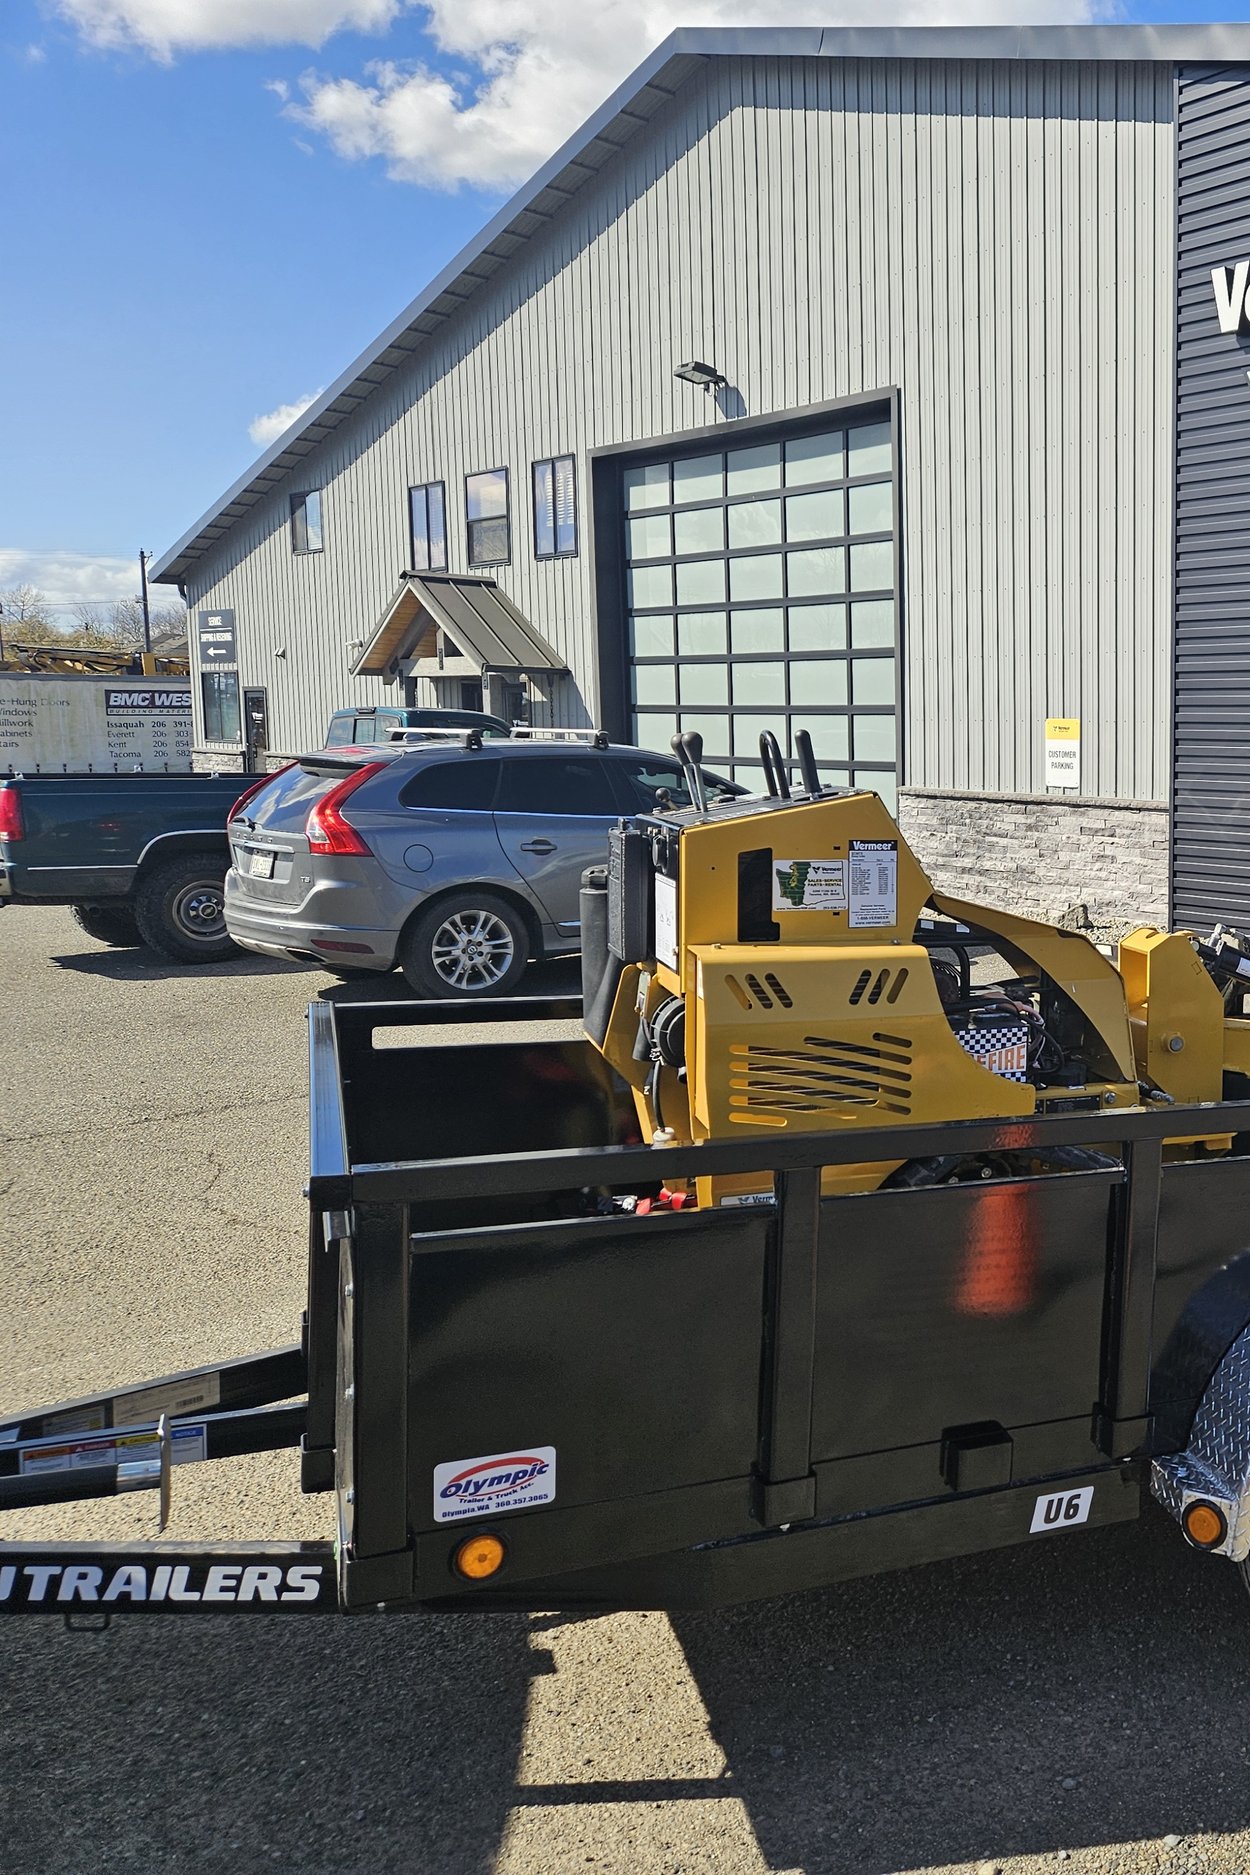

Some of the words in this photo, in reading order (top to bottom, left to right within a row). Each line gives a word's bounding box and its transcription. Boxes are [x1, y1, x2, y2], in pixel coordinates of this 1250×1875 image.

[0, 698, 37, 707] e-Hung
[109, 692, 151, 706] BMC
[154, 693, 192, 706] WES
[107, 721, 145, 729] Issaquah
[1048, 750, 1077, 759] CUSTOMER
[1051, 761, 1074, 770] PARKING
[853, 841, 892, 850] Vermeer
[440, 1463, 549, 1499] Olympic
[459, 1496, 485, 1504] Trailer
[496, 1489, 518, 1500] Truck
[1043, 1493, 1082, 1524] U6
[23, 1565, 323, 1601] TRAILERS
